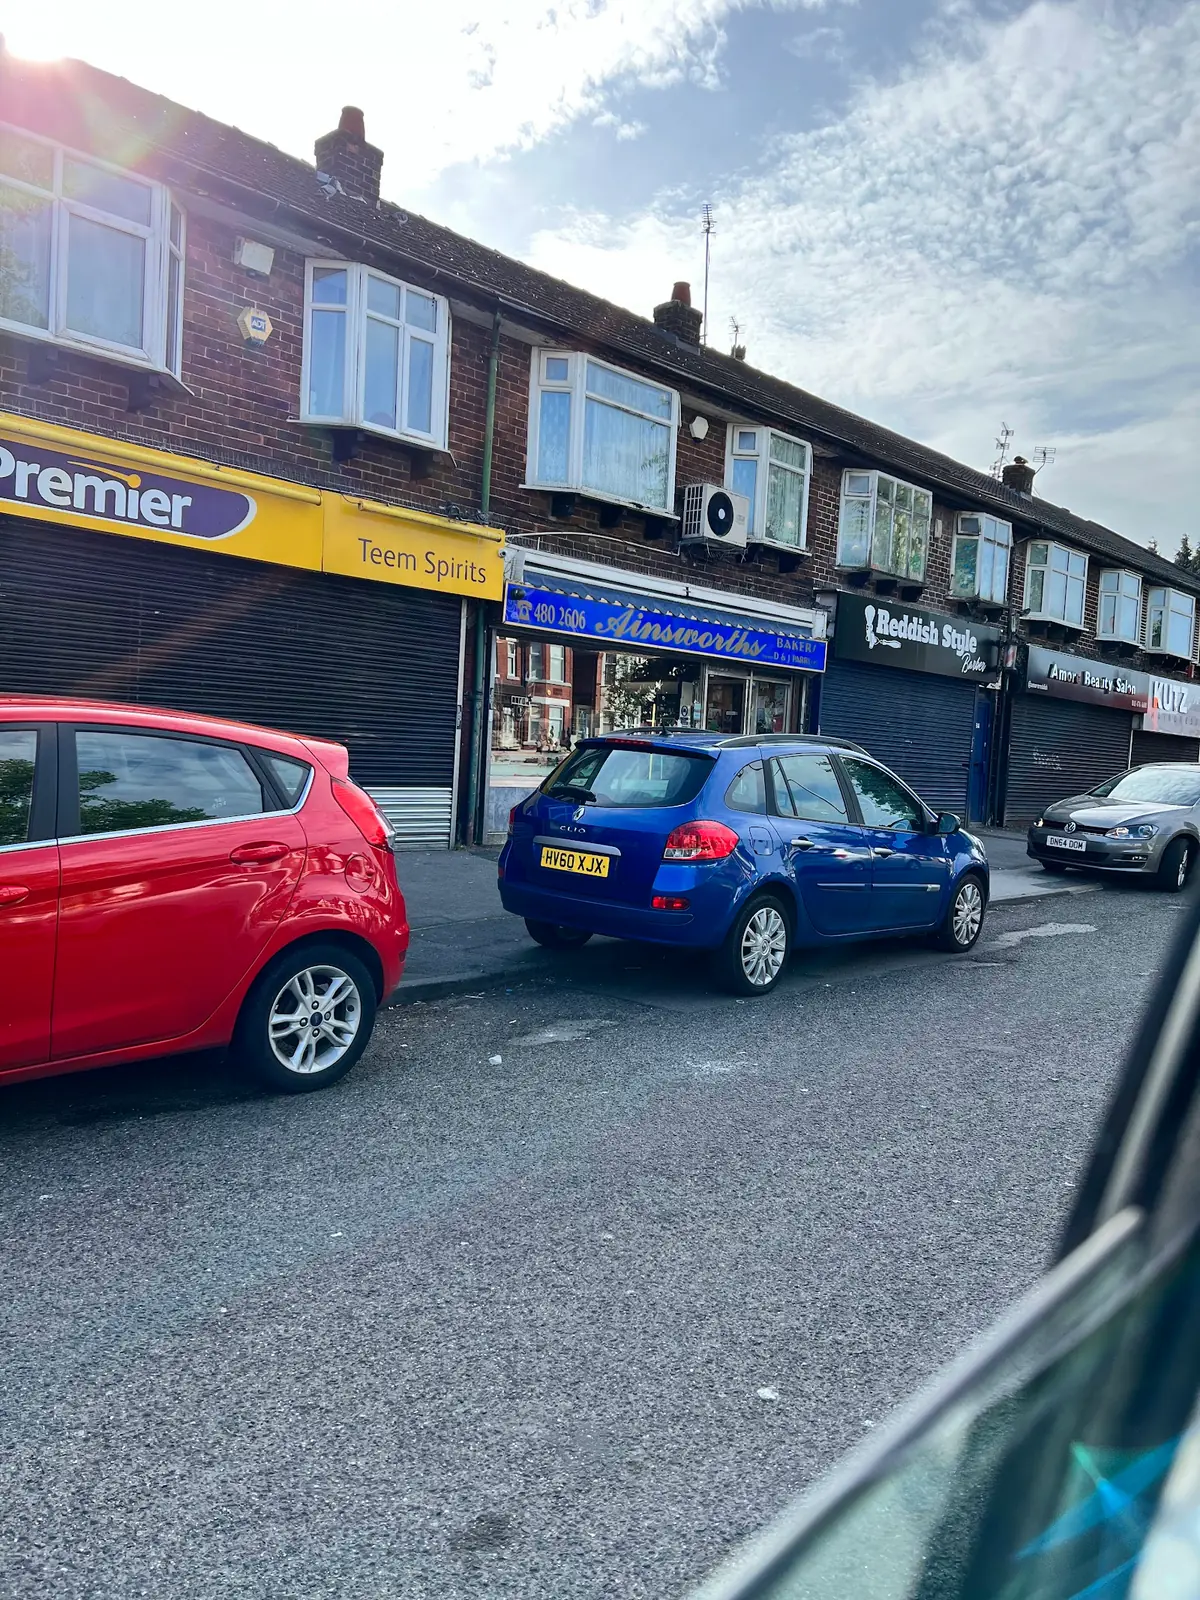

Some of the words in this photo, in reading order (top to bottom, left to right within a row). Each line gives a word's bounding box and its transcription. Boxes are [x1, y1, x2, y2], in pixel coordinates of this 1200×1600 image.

[358, 538, 418, 571] Teem
[424, 551, 487, 584] Spirits
[533, 605, 556, 625] 480
[558, 607, 586, 630] 2606
[595, 608, 767, 657] Ainsworths
[876, 608, 939, 646] Reddish
[941, 623, 977, 657] Style
[773, 652, 779, 660] D
[961, 652, 987, 674] Barber
[1116, 677, 1136, 695] Salon
[1153, 681, 1188, 714] KUTZ
[559, 825, 586, 833] CLIO
[1050, 837, 1067, 847] DN64
[545, 850, 575, 868] HV60
[577, 856, 603, 874] XJX
